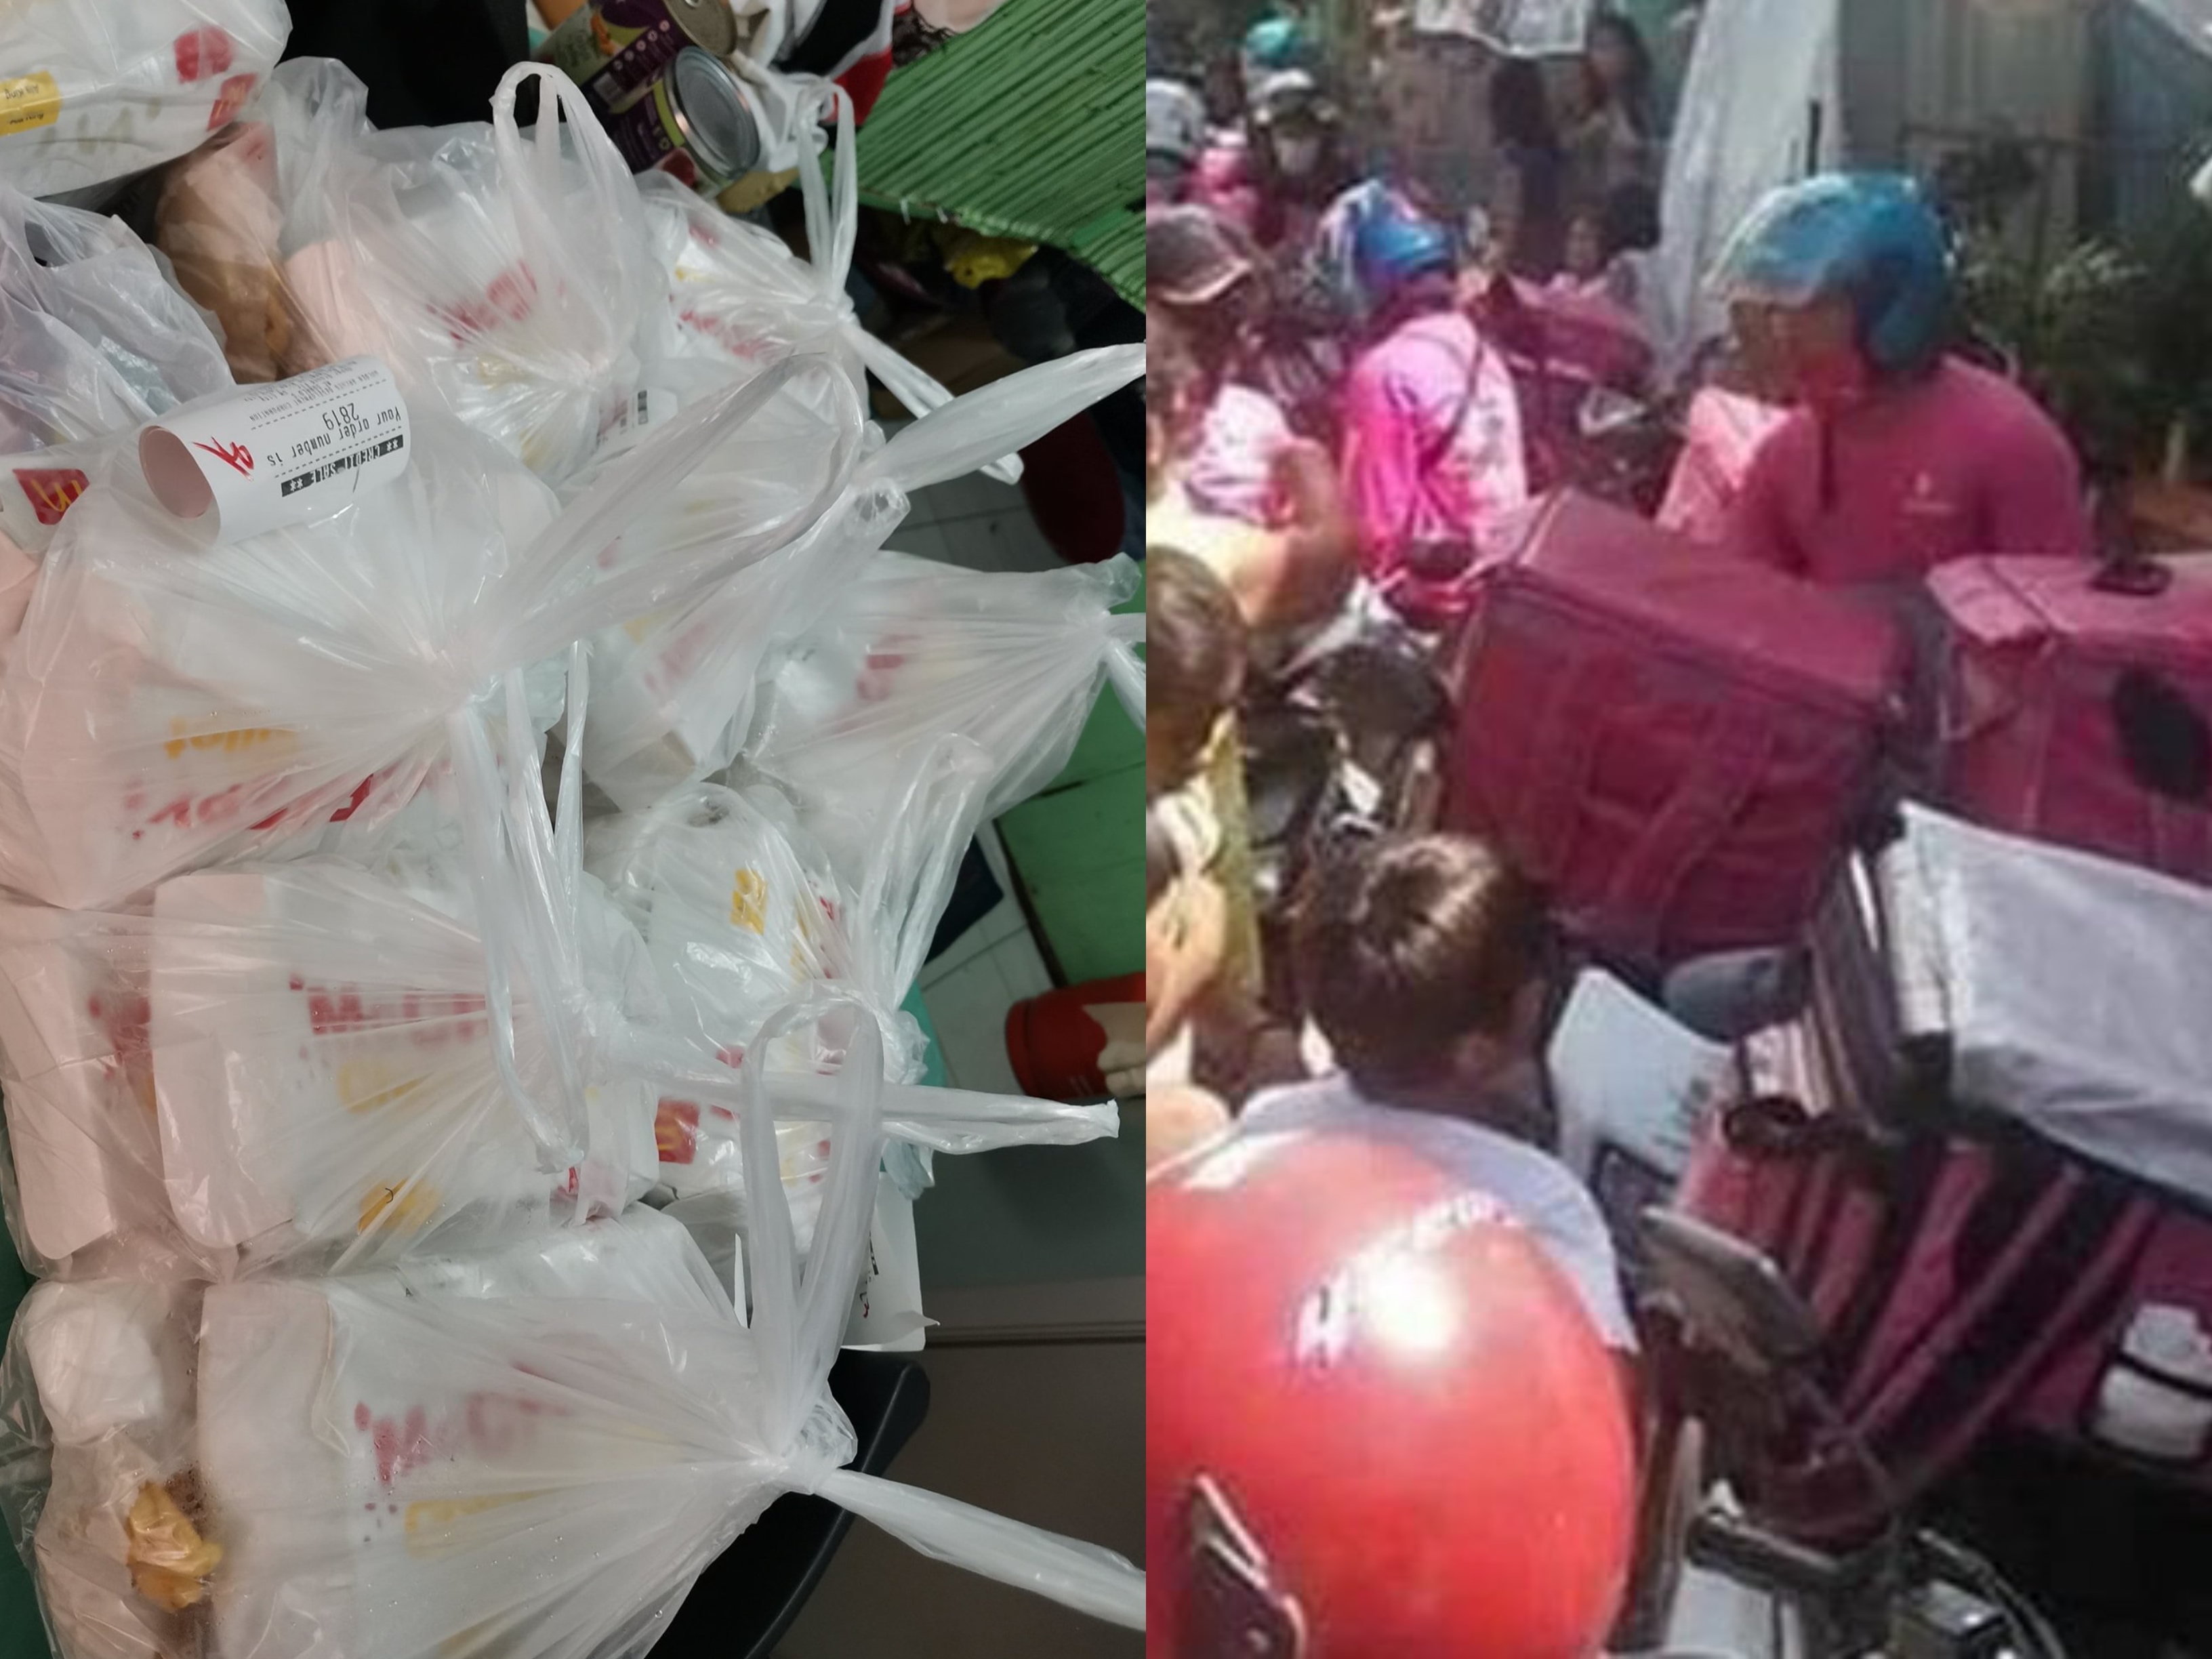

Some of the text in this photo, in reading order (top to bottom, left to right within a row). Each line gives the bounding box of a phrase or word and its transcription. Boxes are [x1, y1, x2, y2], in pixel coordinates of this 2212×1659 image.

[322, 403, 359, 430] 2819
[377, 406, 401, 426] Your
[339, 417, 370, 441] order
[291, 432, 331, 458] number
[267, 452, 283, 466] is
[310, 462, 337, 485] SALE
